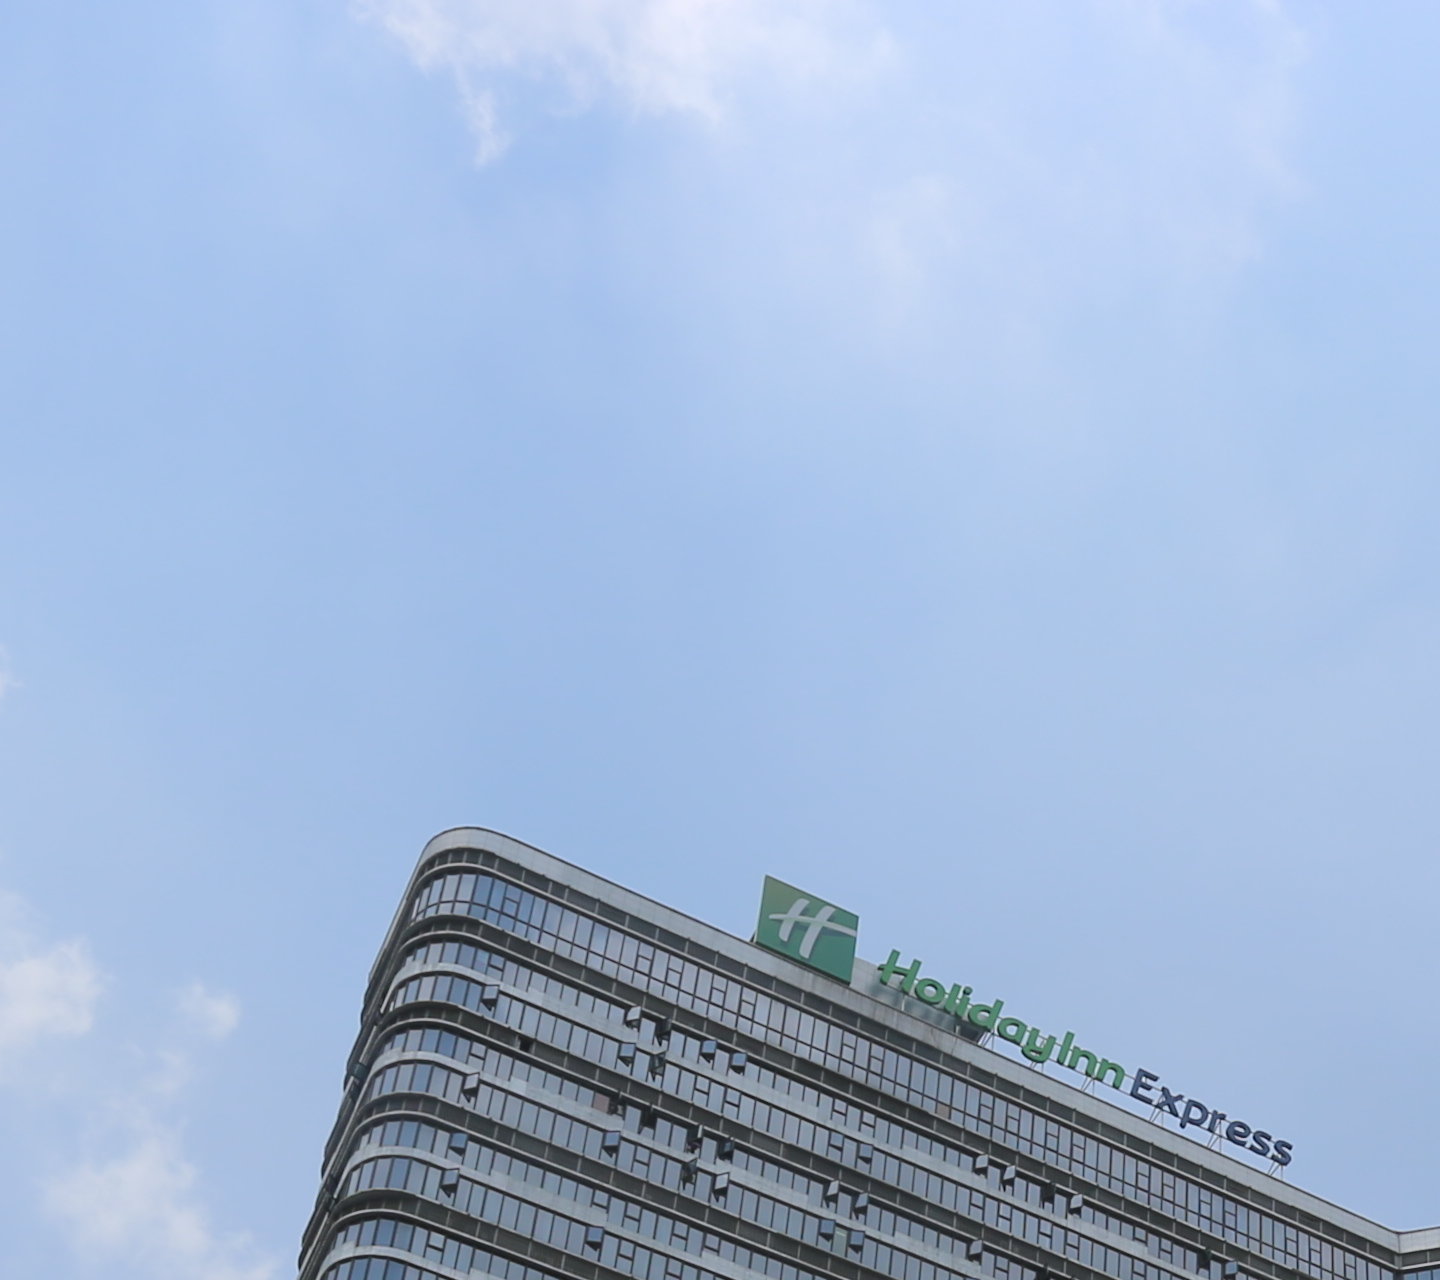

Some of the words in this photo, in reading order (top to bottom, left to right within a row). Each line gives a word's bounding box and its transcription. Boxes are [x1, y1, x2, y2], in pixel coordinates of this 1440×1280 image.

[877, 950, 1058, 1063] Holiday
[1059, 1032, 1126, 1089] Inn
[1130, 1069, 1293, 1167] Express
